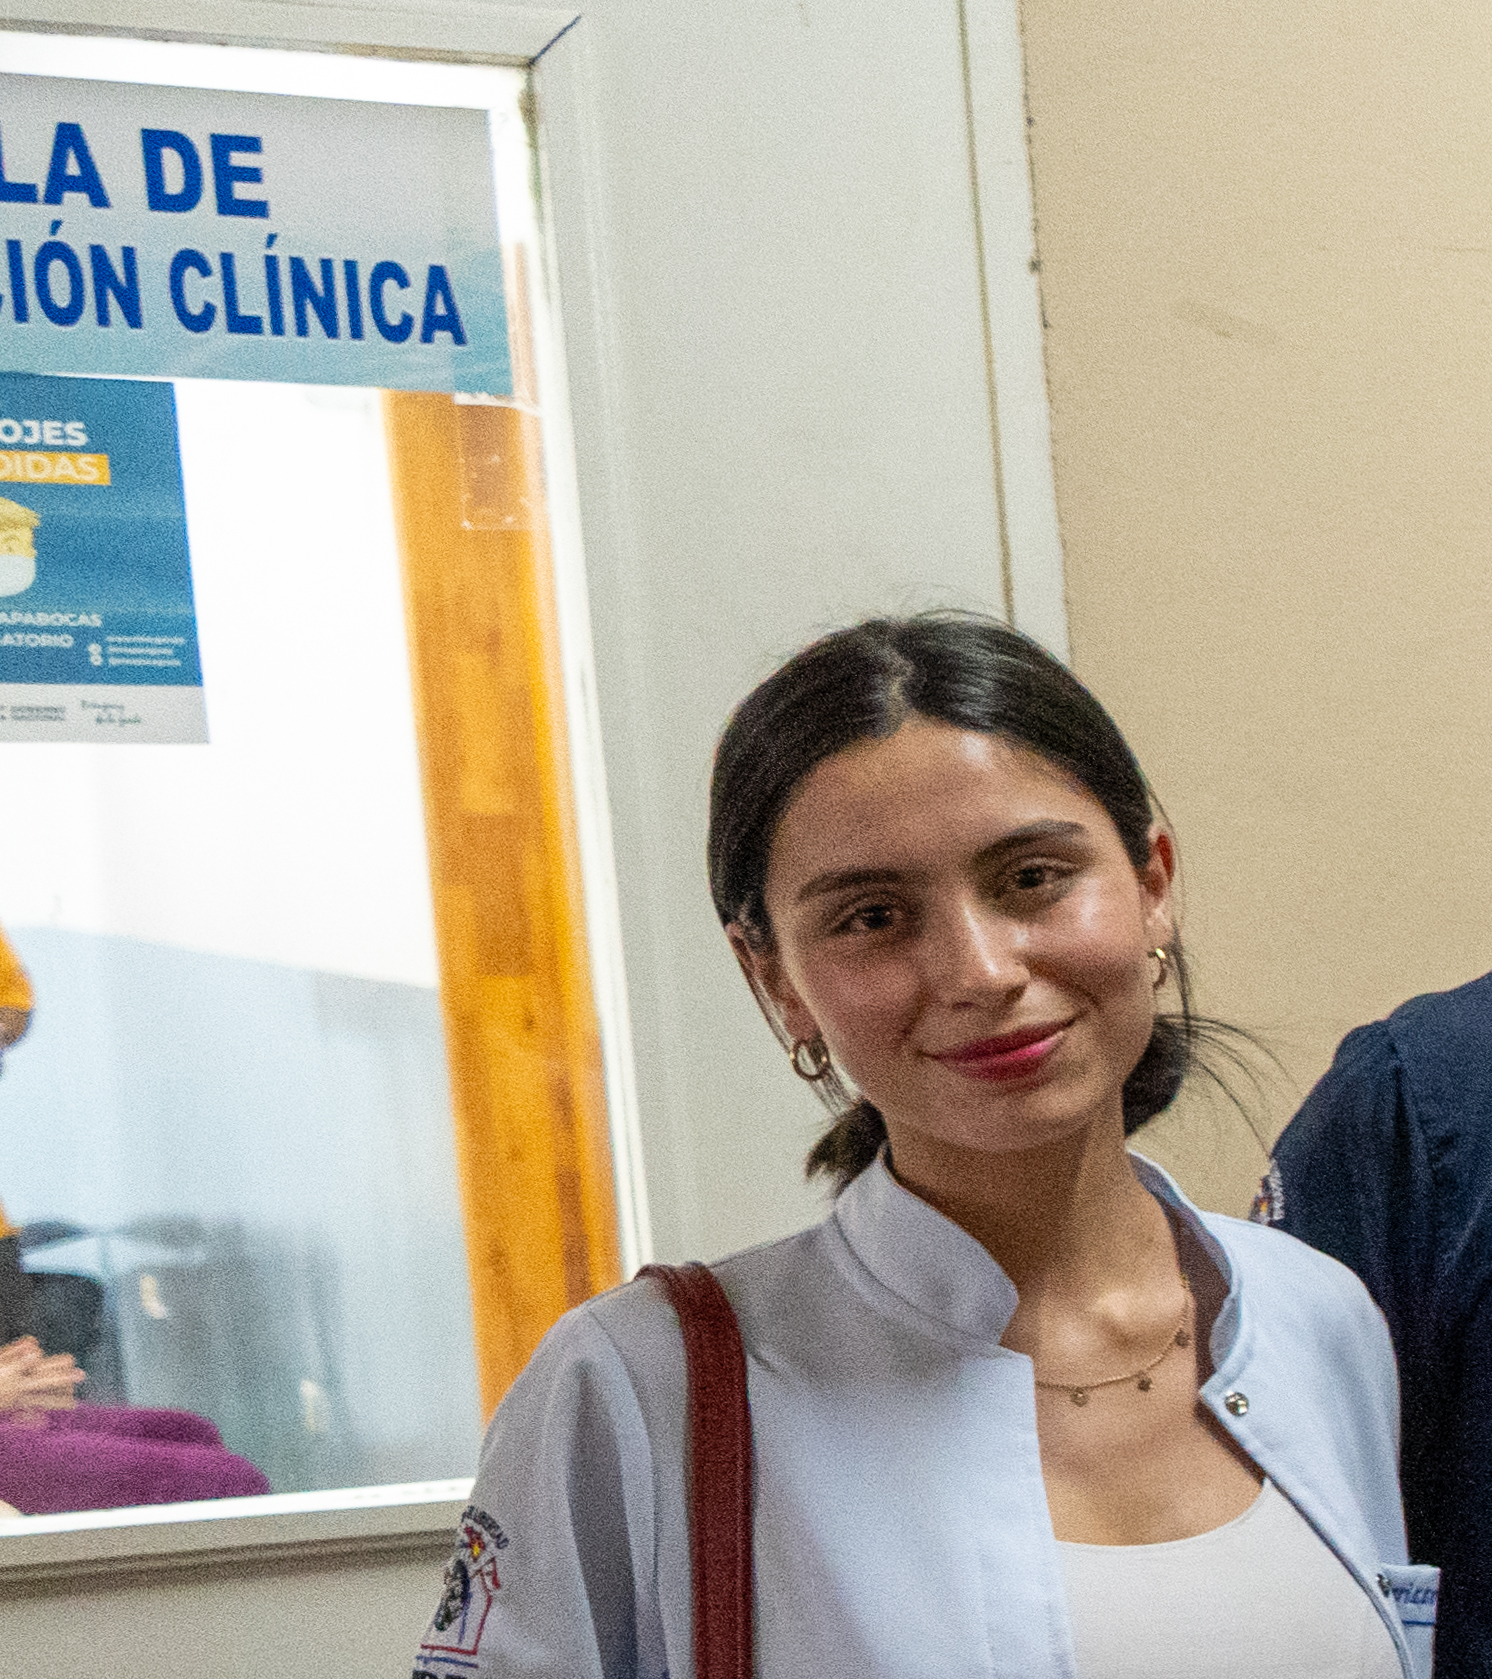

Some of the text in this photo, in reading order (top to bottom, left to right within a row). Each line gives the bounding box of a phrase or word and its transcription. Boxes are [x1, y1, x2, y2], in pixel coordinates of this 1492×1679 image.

[141, 128, 269, 219] DE
[0, 220, 467, 346] IÓN CLÍNICA
